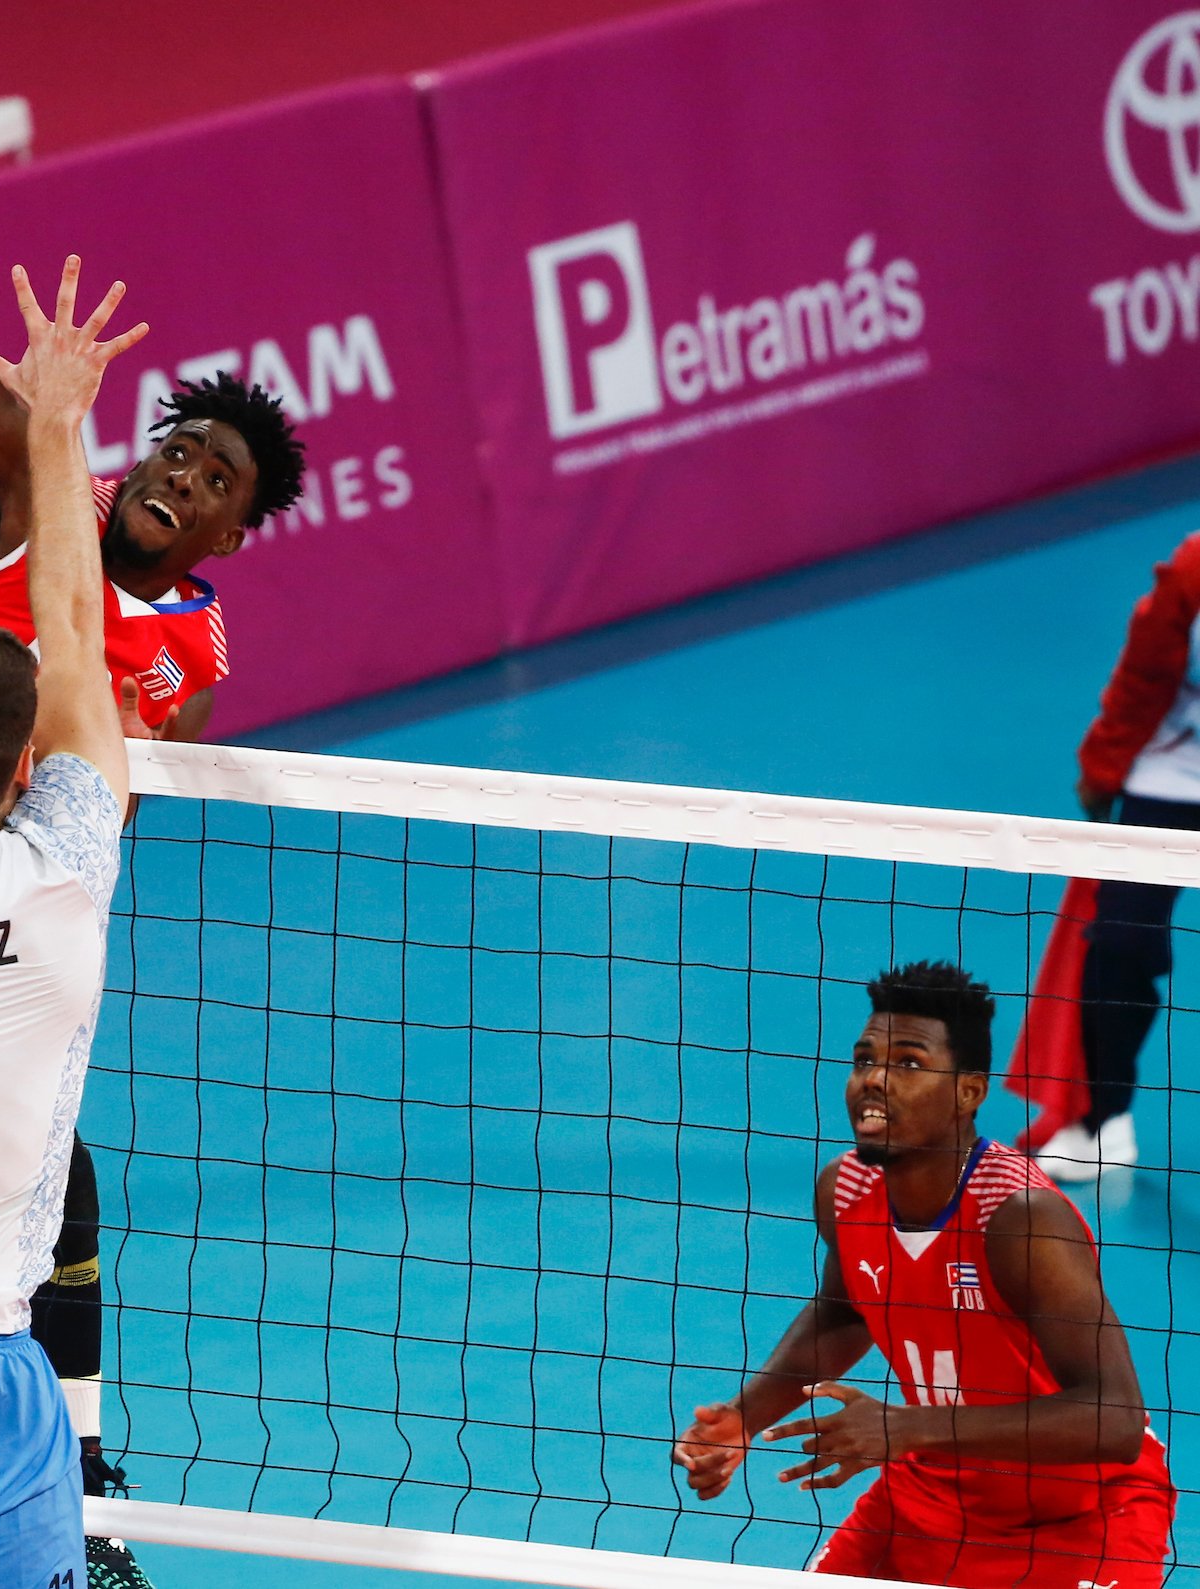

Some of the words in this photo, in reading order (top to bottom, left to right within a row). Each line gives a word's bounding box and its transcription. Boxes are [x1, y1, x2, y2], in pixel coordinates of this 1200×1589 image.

[555, 232, 925, 417] Petramás
[135, 668, 174, 701] CUB
[952, 1288, 986, 1311] CUB
